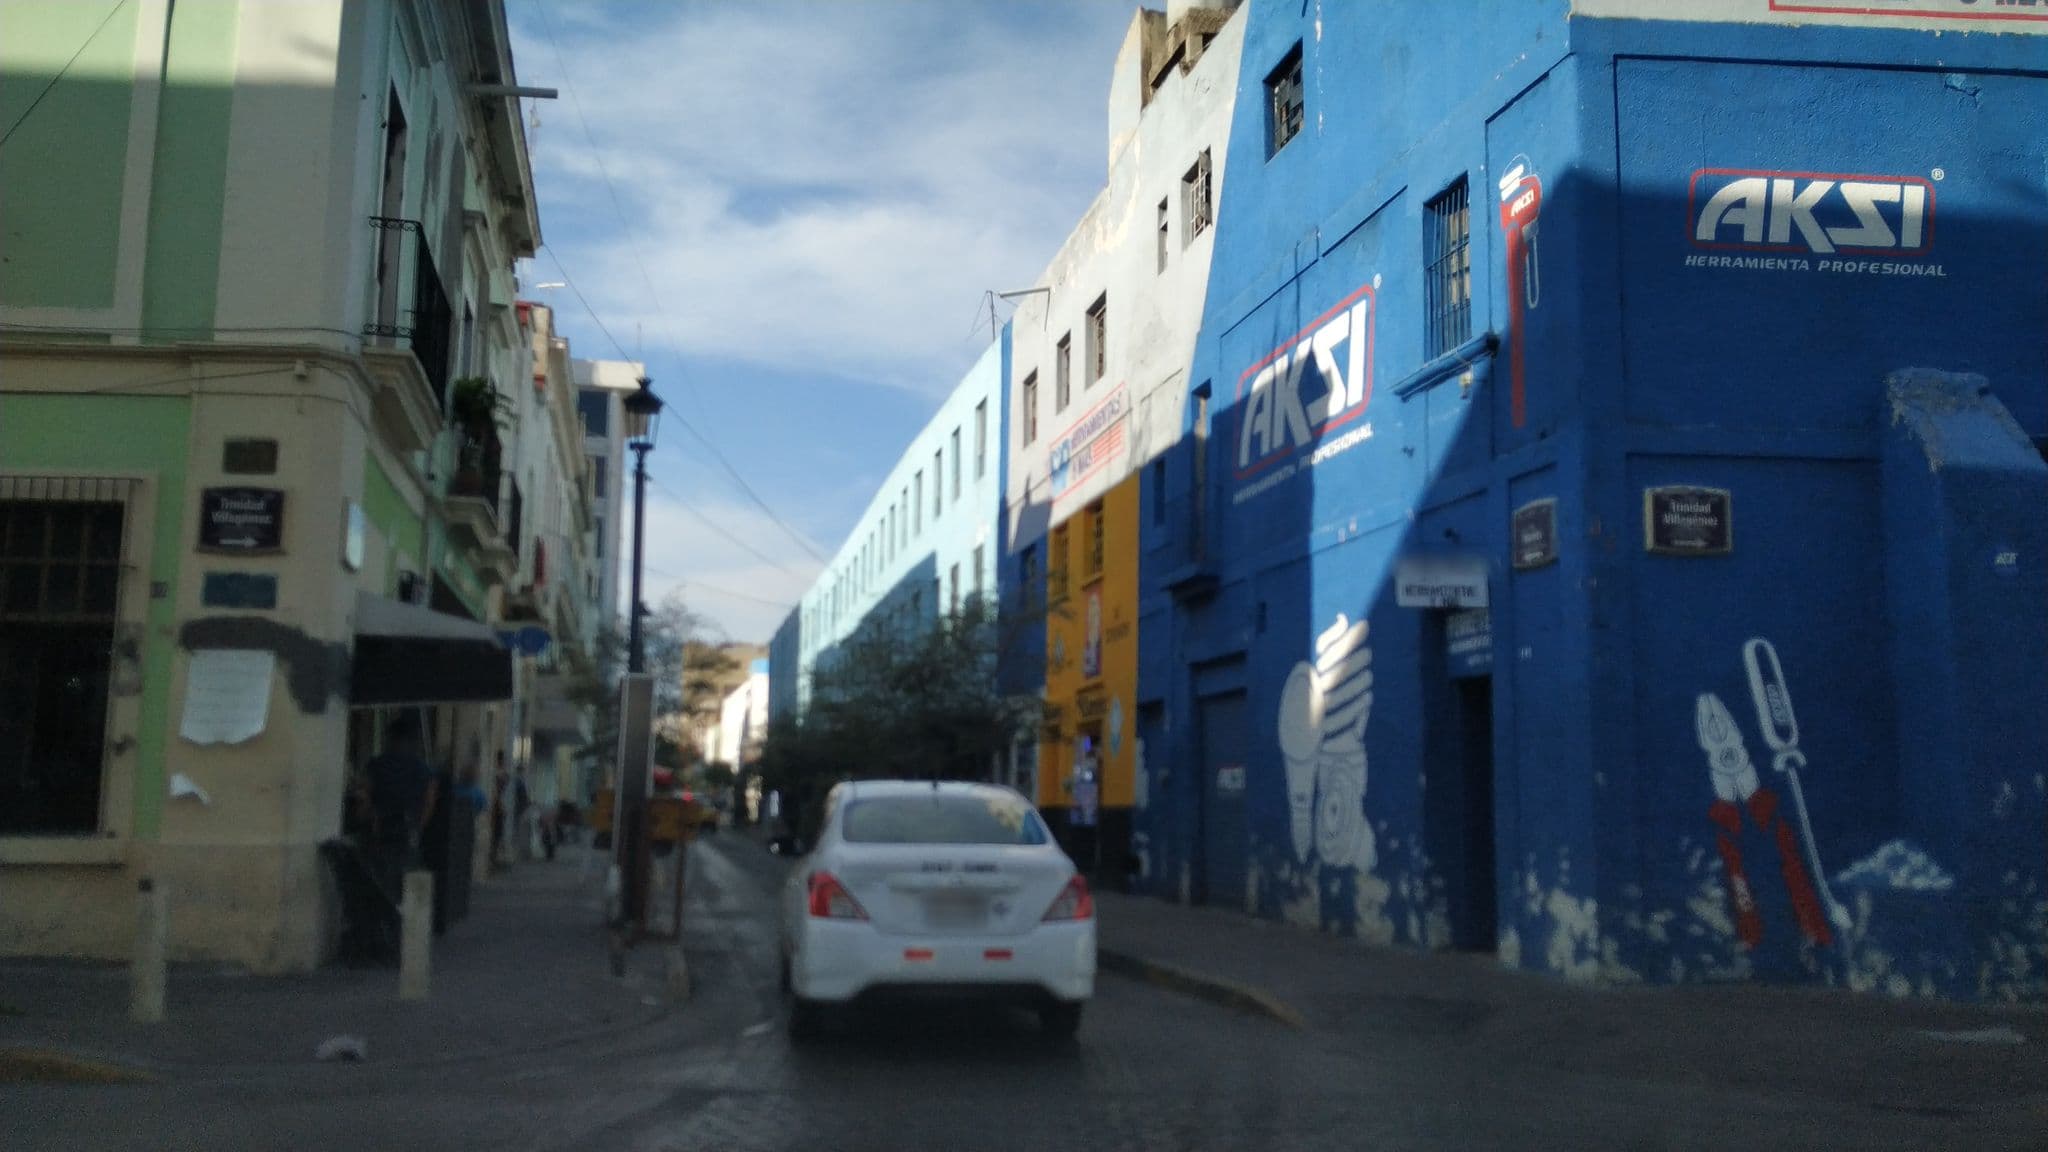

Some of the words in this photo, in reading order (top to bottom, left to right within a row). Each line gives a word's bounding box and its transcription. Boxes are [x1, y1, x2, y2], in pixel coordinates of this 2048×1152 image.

[1696, 177, 1926, 254] AKSI
[1685, 255, 1810, 271] HERRAMIENTA
[1818, 260, 1947, 277] PROFESIONAL
[1239, 299, 1367, 469] AKSI
[1671, 502, 1712, 513] Trinidad
